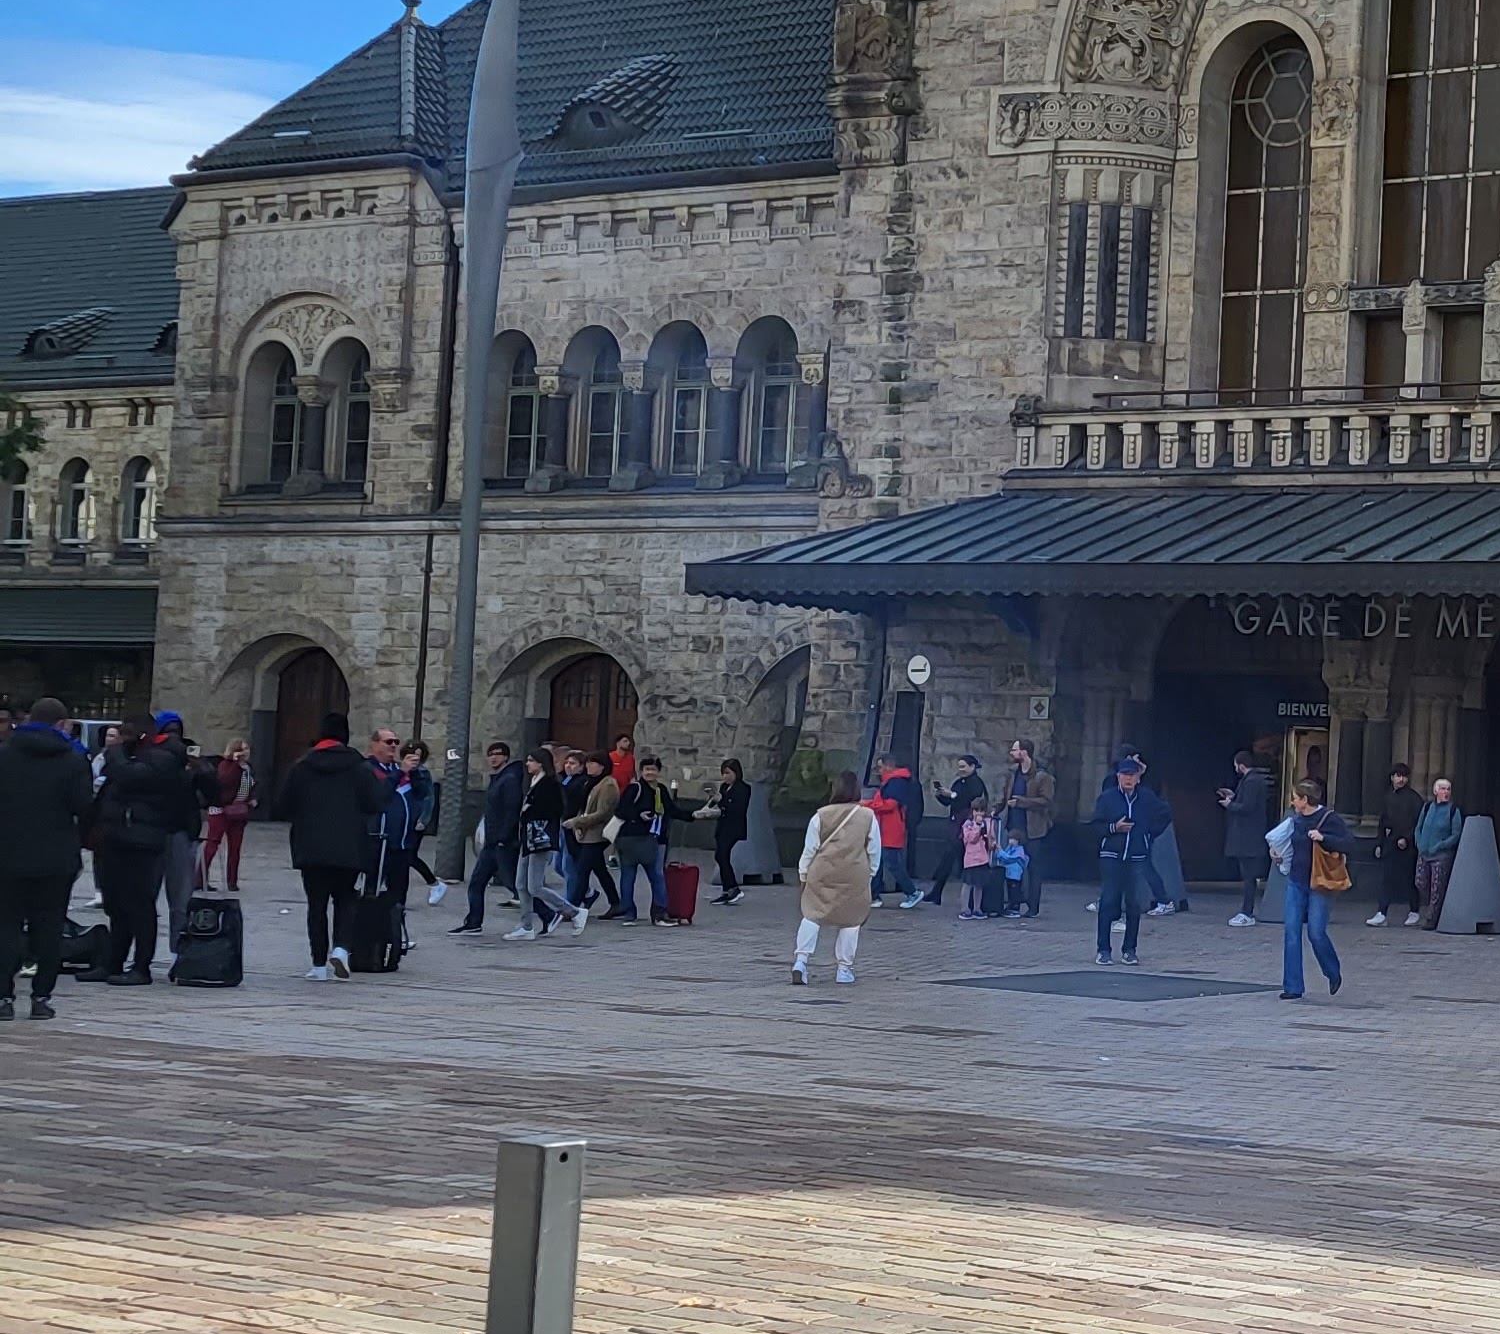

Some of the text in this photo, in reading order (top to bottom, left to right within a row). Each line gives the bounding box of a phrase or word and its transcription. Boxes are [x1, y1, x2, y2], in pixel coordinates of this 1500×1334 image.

[1233, 601, 1342, 638] GARE
[1363, 601, 1413, 638] DE
[1277, 702, 1331, 717] BIENVE
